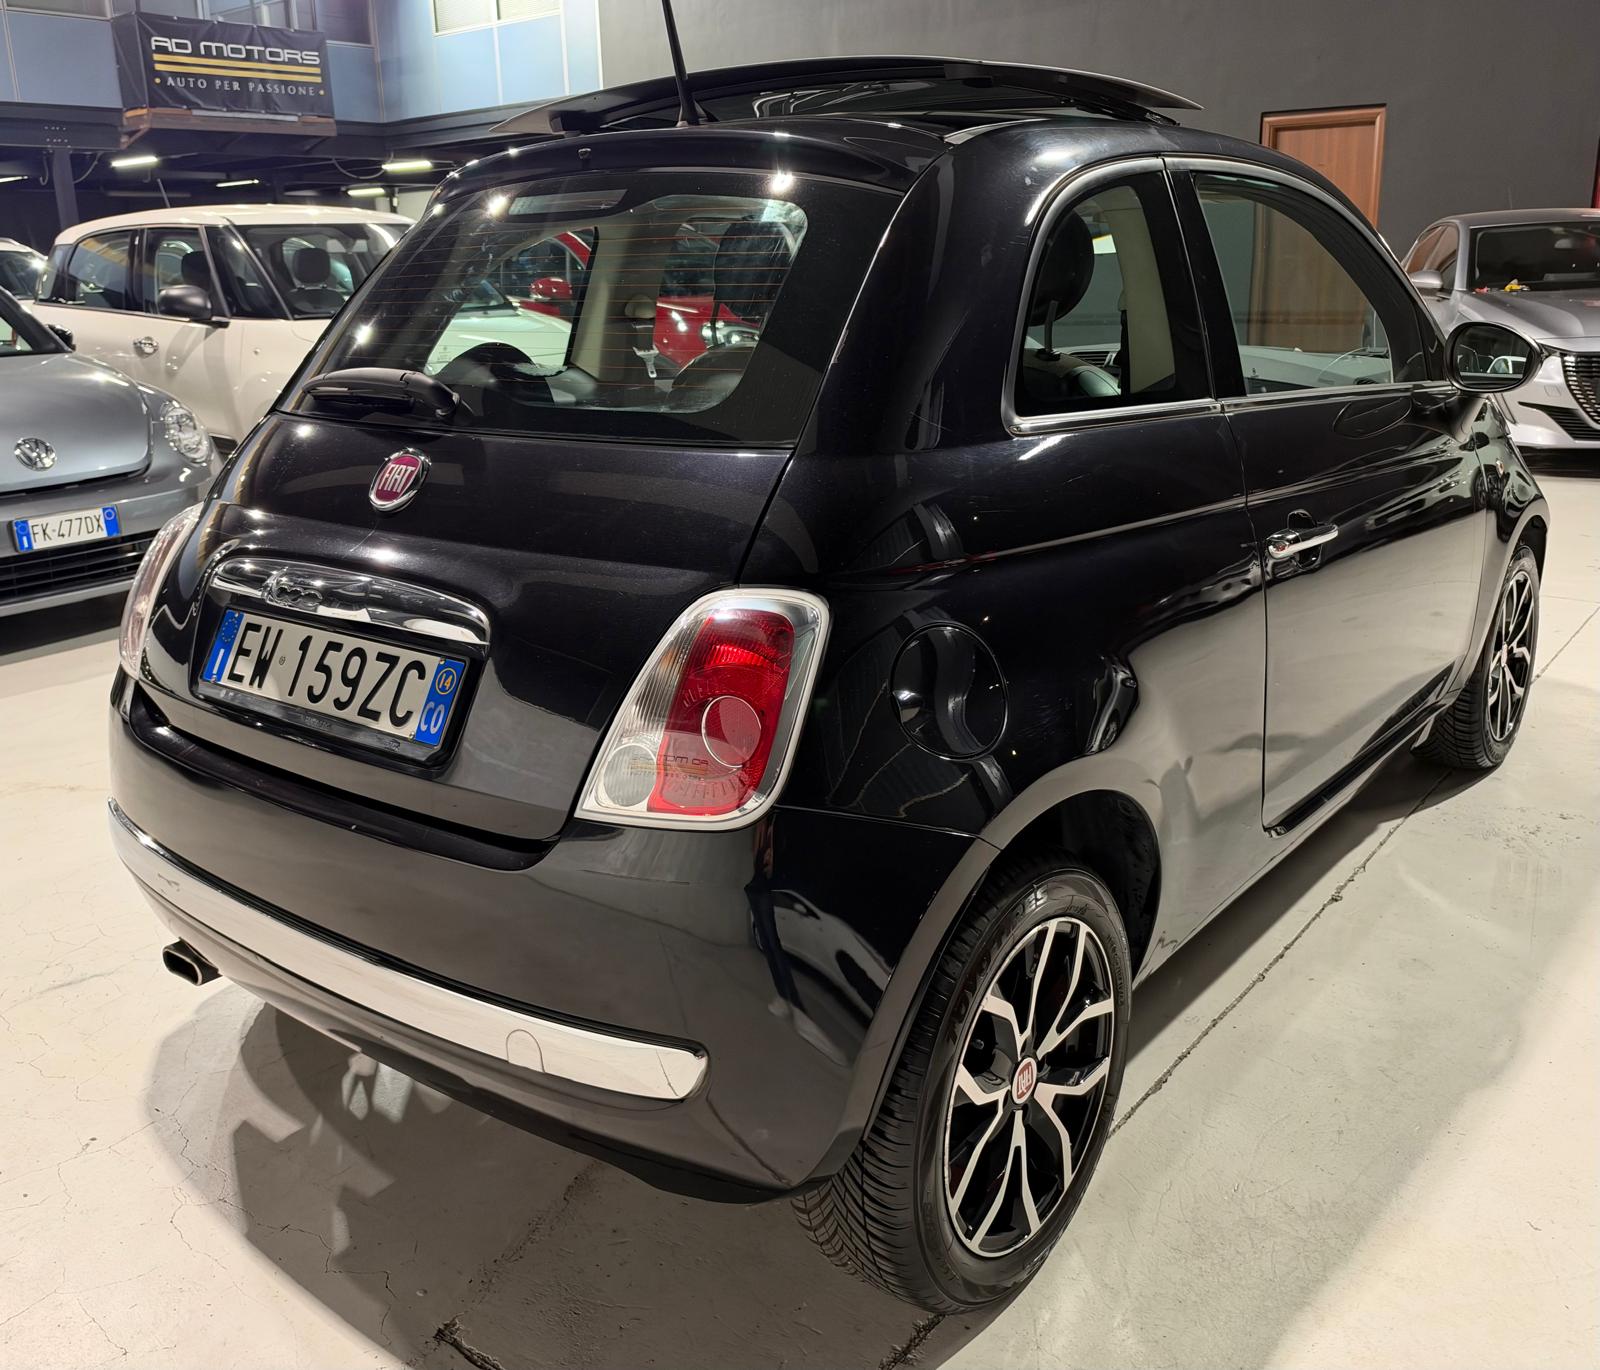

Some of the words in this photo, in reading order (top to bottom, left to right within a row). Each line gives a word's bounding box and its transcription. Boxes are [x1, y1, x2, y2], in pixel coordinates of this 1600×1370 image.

[150, 36, 192, 54] AD
[199, 41, 321, 65] MOTORS
[166, 76, 208, 89] AUTO
[215, 79, 240, 92] PER
[248, 81, 316, 96] PASSIONE
[378, 463, 417, 493] FIAT
[439, 672, 453, 691] 14
[419, 701, 446, 735] CO
